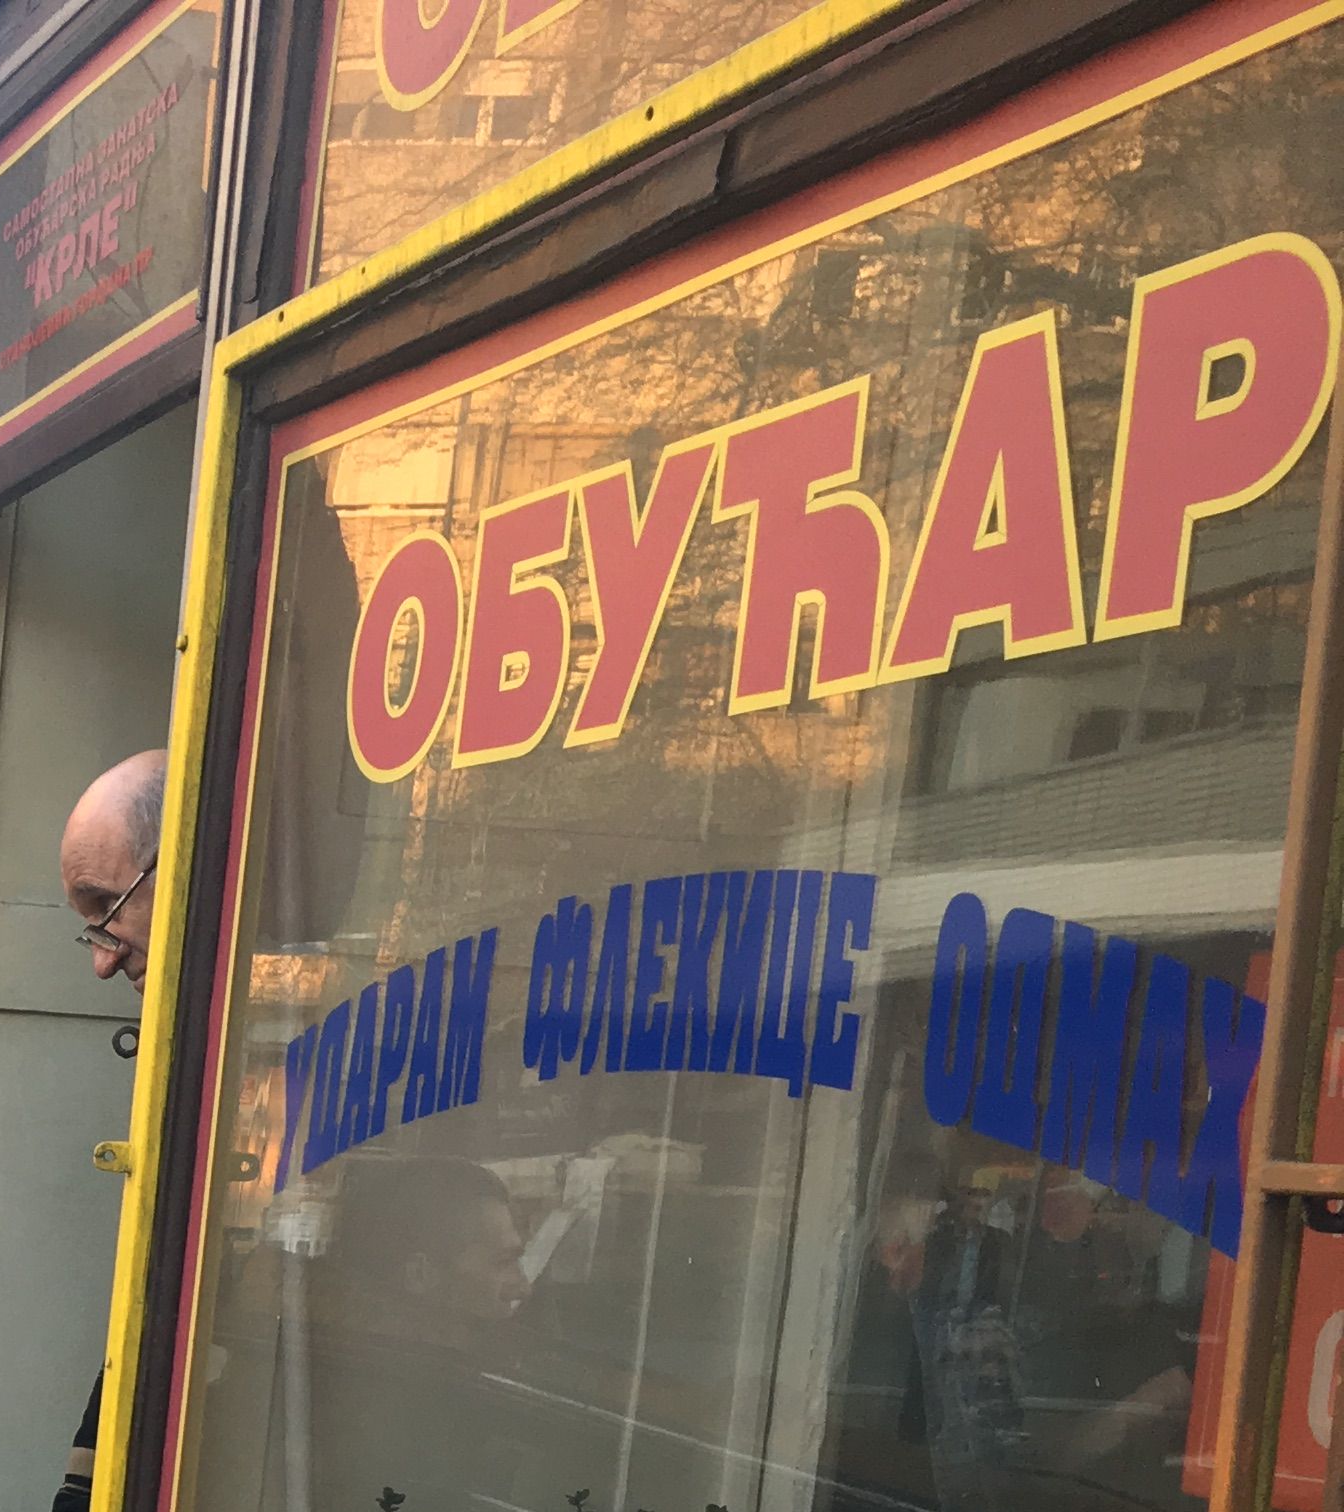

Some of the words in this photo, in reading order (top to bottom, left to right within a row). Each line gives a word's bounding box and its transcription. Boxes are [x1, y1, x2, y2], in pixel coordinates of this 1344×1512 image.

[346, 231, 1343, 785] ОБУЋАР
[273, 926, 500, 1195] УДАРАМ
[522, 868, 878, 1099] ФЛЕКИЦЕ
[922, 890, 1267, 1262] ОДМАХ
